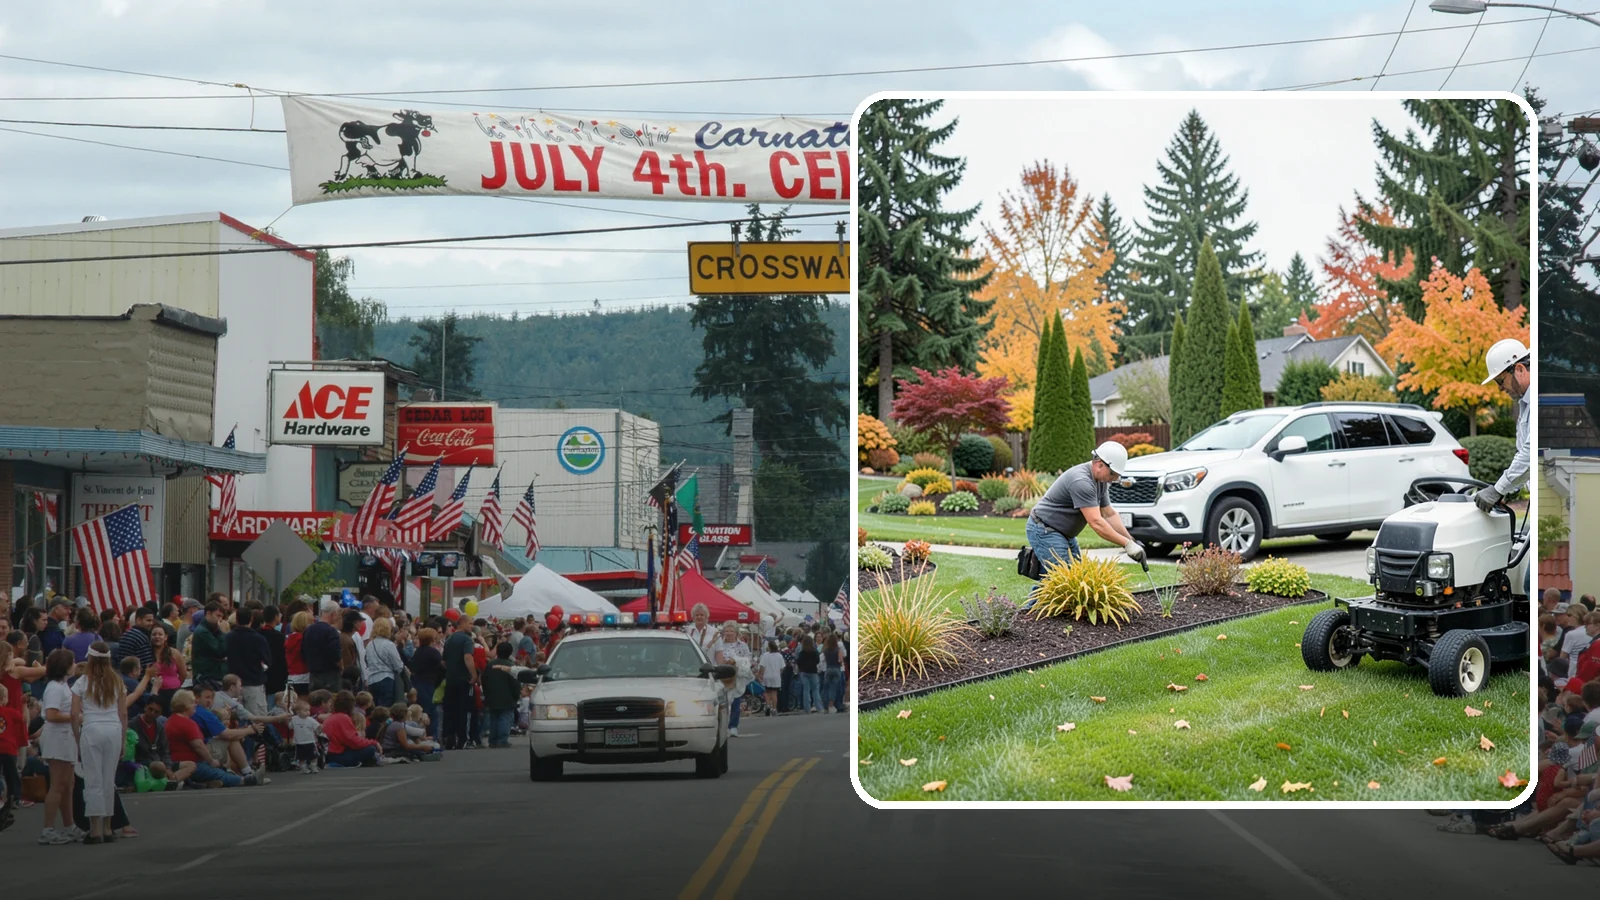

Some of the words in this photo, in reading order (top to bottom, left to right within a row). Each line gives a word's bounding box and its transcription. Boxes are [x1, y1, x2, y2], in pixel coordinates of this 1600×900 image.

[694, 121, 850, 150] Carnat
[481, 141, 605, 192] JULY
[632, 149, 747, 198] 4th.
[697, 254, 850, 280] CROSSWA
[282, 380, 373, 420] ACE
[405, 410, 452, 422] CEDAR
[462, 410, 485, 422] LOG
[283, 421, 370, 436] Hardware
[416, 428, 476, 446] Coca-Cola
[353, 467, 386, 480] Simpl
[83, 485, 94, 494] St.
[96, 485, 124, 494] Vincent
[126, 486, 136, 494] de
[138, 486, 155, 495] Paul
[81, 503, 154, 521] THT
[688, 526, 741, 535] CRNATION
